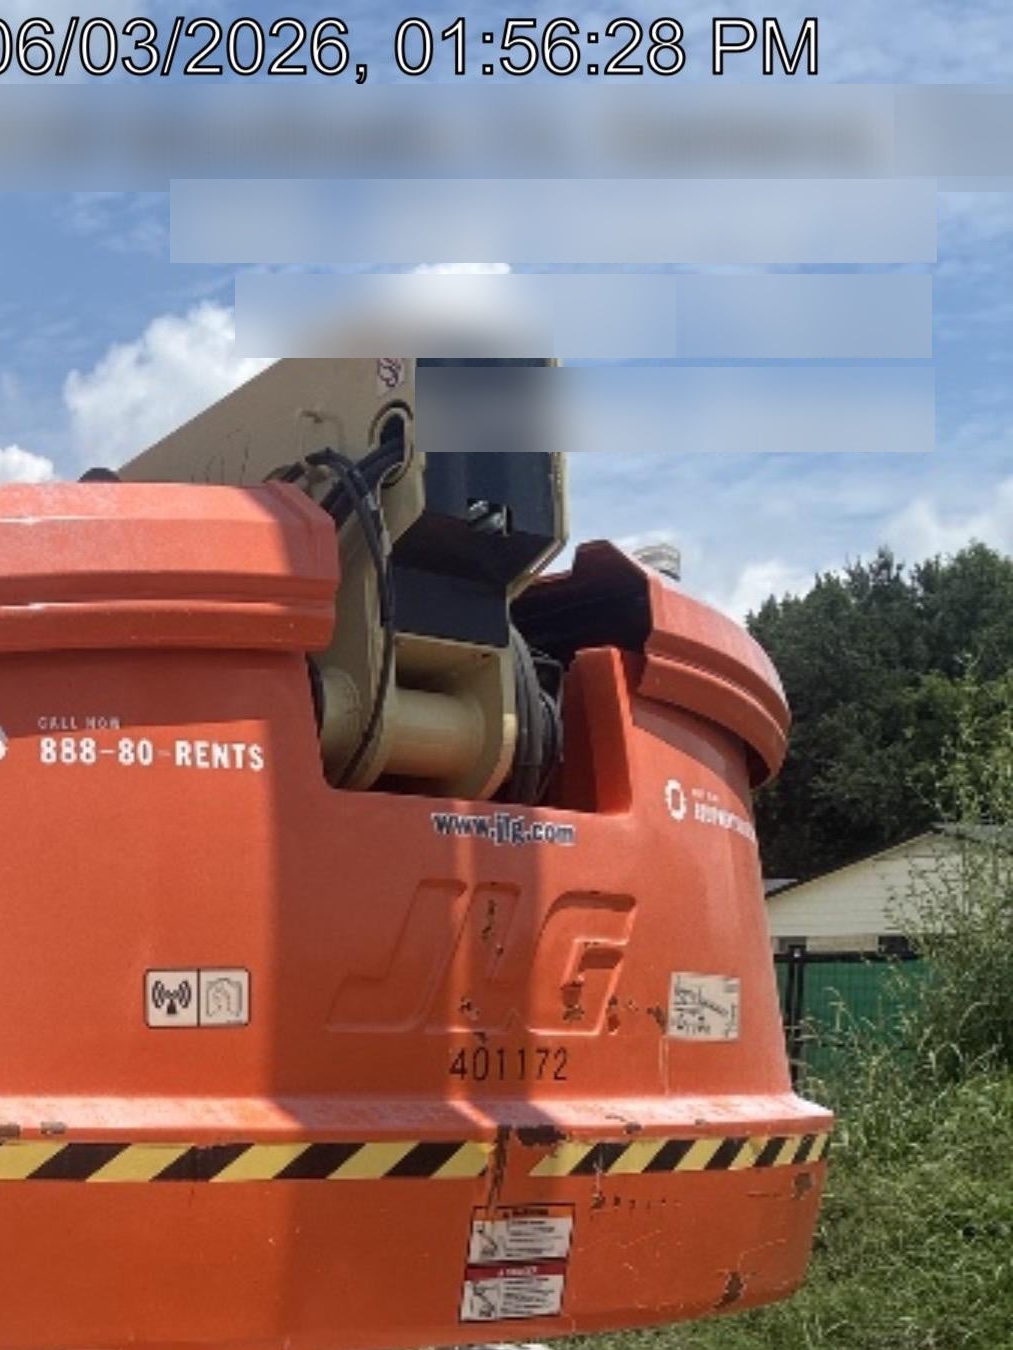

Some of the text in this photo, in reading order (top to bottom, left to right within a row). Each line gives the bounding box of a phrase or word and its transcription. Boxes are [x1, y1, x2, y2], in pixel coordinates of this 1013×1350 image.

[431, 812, 575, 846] www.jlg.com
[326, 878, 637, 1036] JLG
[449, 1047, 567, 1081] 401172
